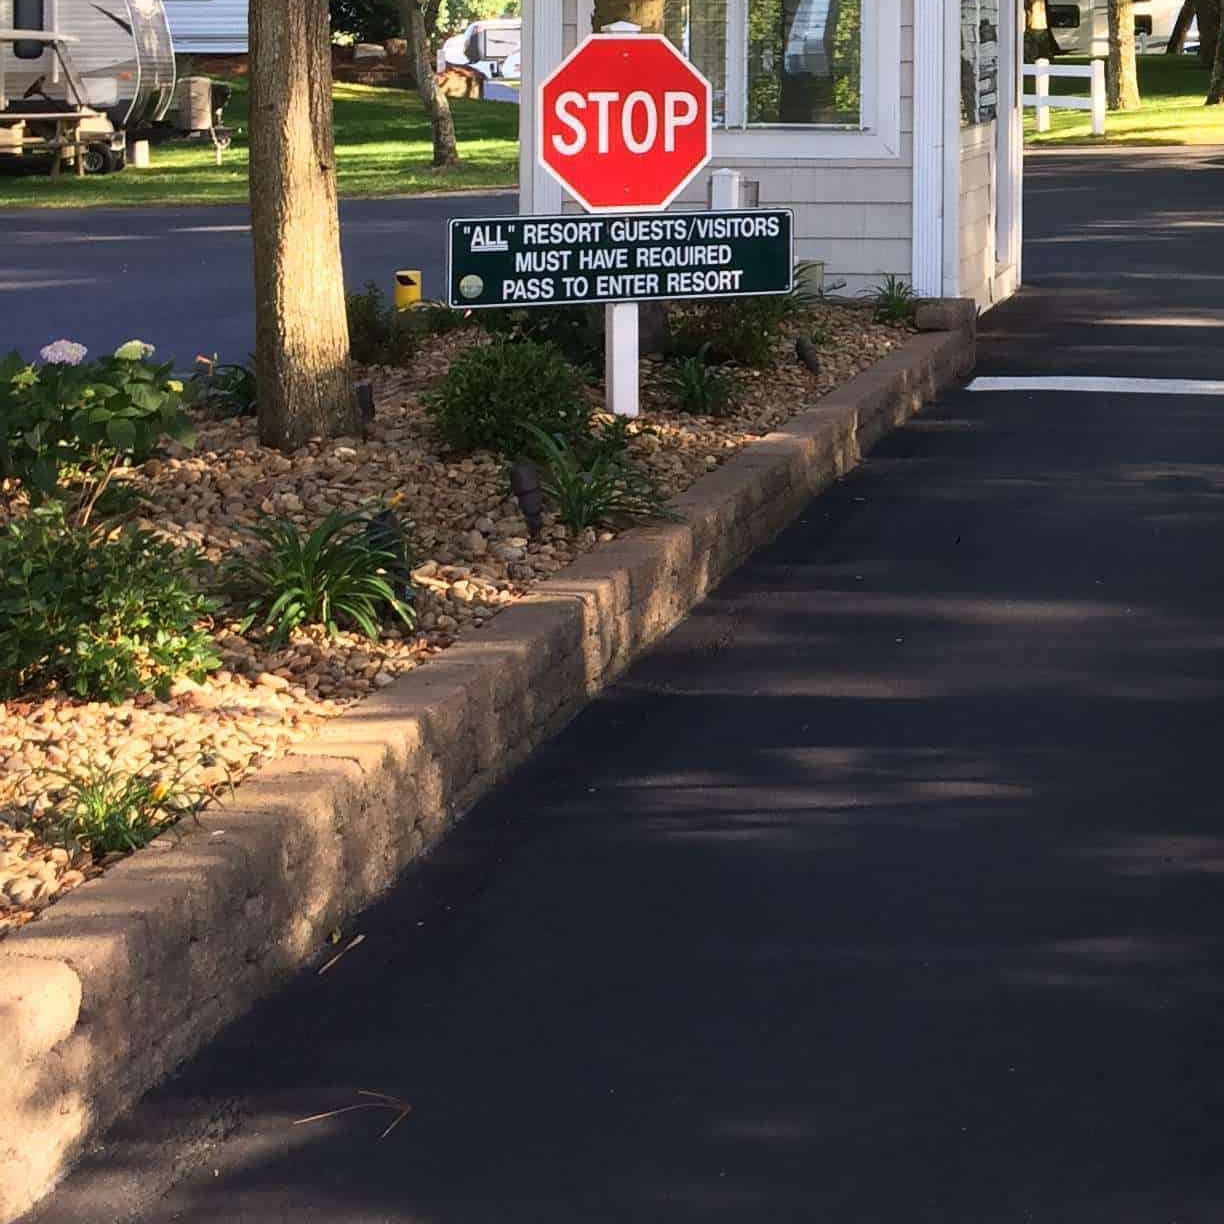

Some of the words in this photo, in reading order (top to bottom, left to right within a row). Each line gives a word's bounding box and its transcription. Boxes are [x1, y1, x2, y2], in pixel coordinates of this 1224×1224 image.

[552, 91, 698, 155] STOP
[523, 222, 603, 244] RESORT
[611, 217, 779, 242] GUESTS/VISITORS
[515, 250, 572, 272] MUST
[579, 248, 628, 269] HAVE
[636, 245, 732, 267] REQUIRED
[502, 278, 554, 300] PASS
[562, 276, 589, 297] TO
[597, 273, 659, 296] ENTER
[667, 270, 743, 293] RESORT
